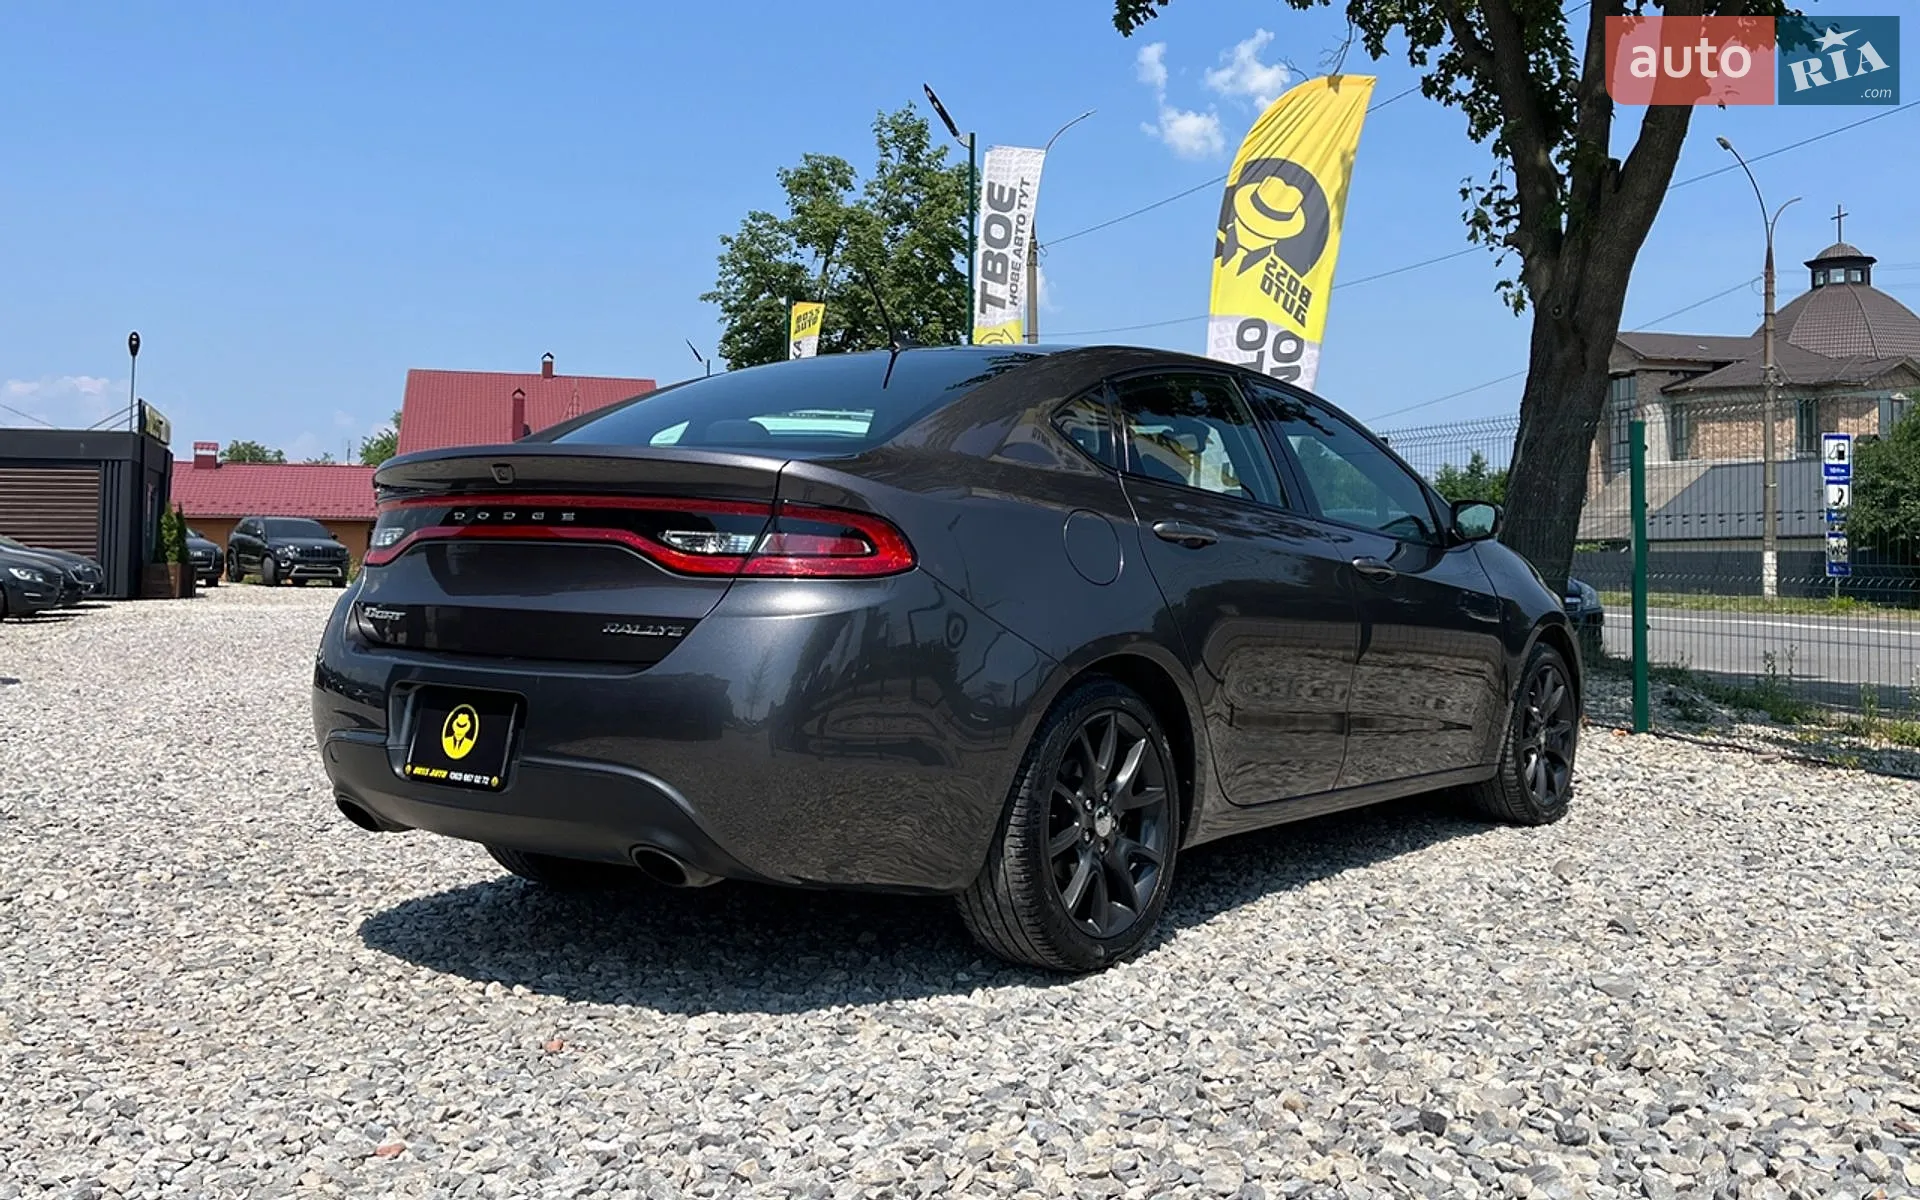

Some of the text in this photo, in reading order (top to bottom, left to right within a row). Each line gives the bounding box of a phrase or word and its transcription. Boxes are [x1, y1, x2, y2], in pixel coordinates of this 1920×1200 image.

[979, 180, 1017, 315] ТВОЕ
[1009, 177, 1031, 307] НОВЕ АВТО ТУТ
[454, 511, 576, 521] DODGE
[602, 623, 685, 637] RALLYE
